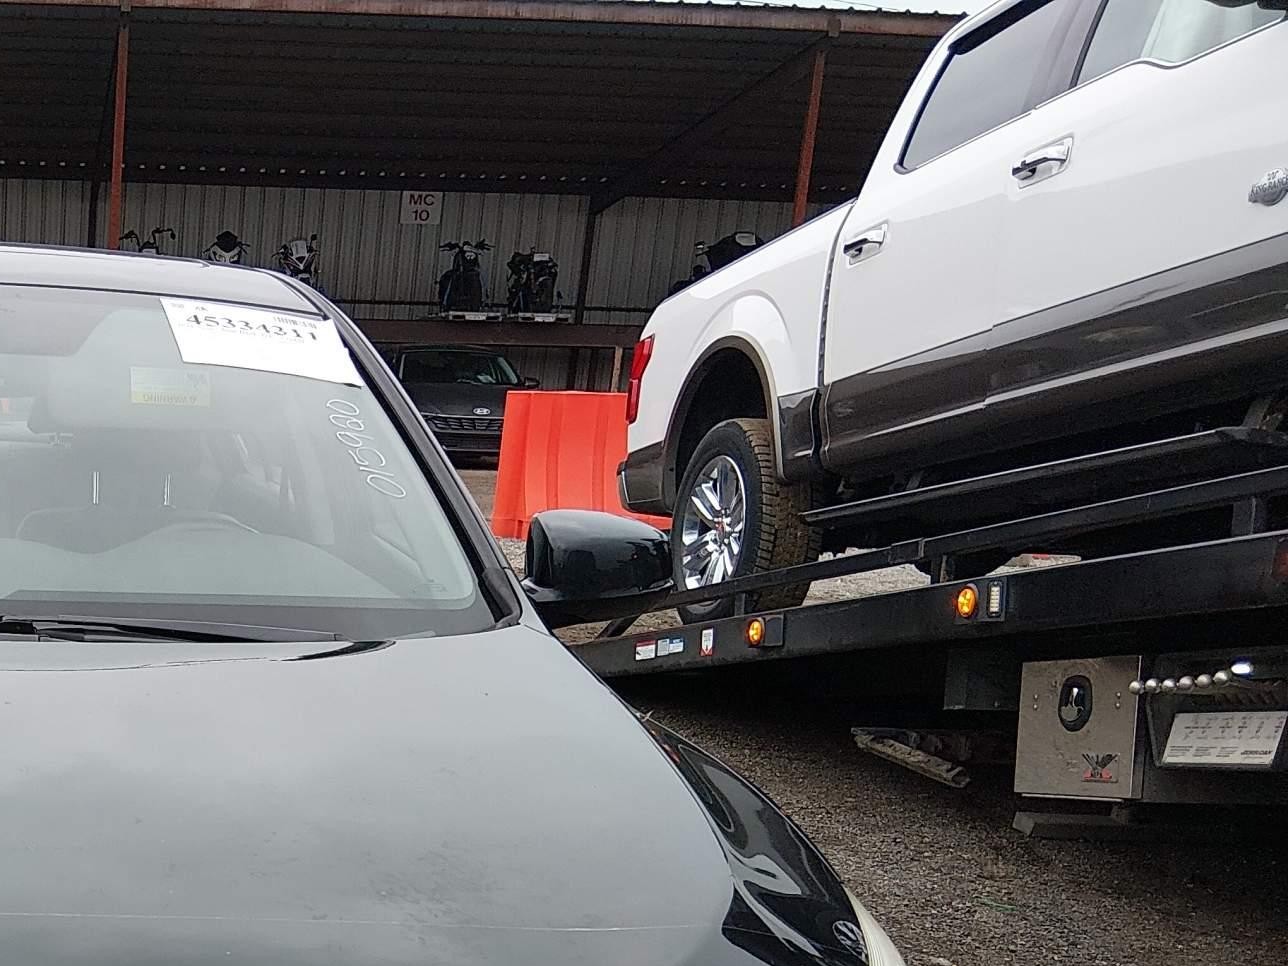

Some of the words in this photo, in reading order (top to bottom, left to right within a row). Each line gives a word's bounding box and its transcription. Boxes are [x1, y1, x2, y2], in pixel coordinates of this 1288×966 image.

[409, 193, 435, 206] MC
[412, 209, 430, 222] 10
[185, 314, 318, 341] 45334311
